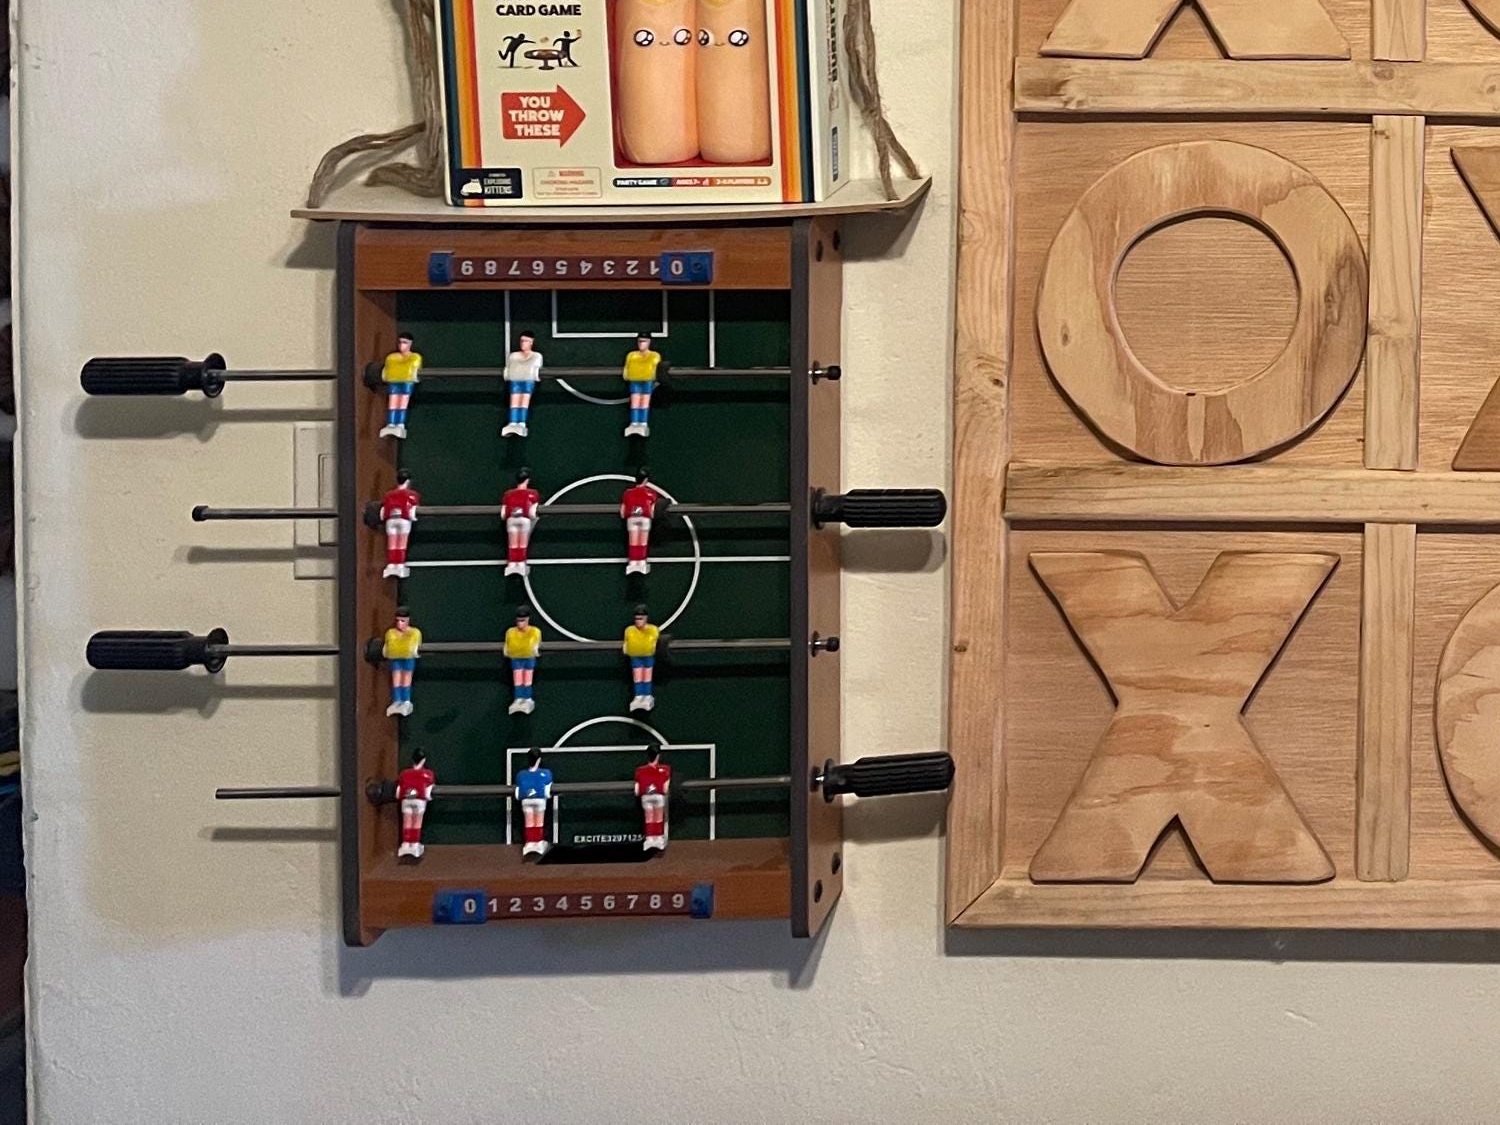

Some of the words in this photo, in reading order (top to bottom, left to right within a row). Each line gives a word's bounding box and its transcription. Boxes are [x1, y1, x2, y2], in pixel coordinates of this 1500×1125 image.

[495, 4, 536, 16] CARD
[538, 4, 582, 16] GAME
[519, 95, 551, 109] YOU
[508, 109, 565, 122] THROW
[514, 124, 561, 137] THESE
[484, 185, 513, 195] KITTENS
[464, 899, 477, 913] 0
[489, 898, 500, 912] 1
[509, 898, 522, 911] 2
[532, 897, 545, 911] 3
[555, 896, 568, 910] 4
[580, 896, 592, 910] 5
[604, 895, 615, 909] 6
[626, 895, 638, 909] 7
[649, 894, 661, 908] 8
[672, 893, 685, 908] 9
